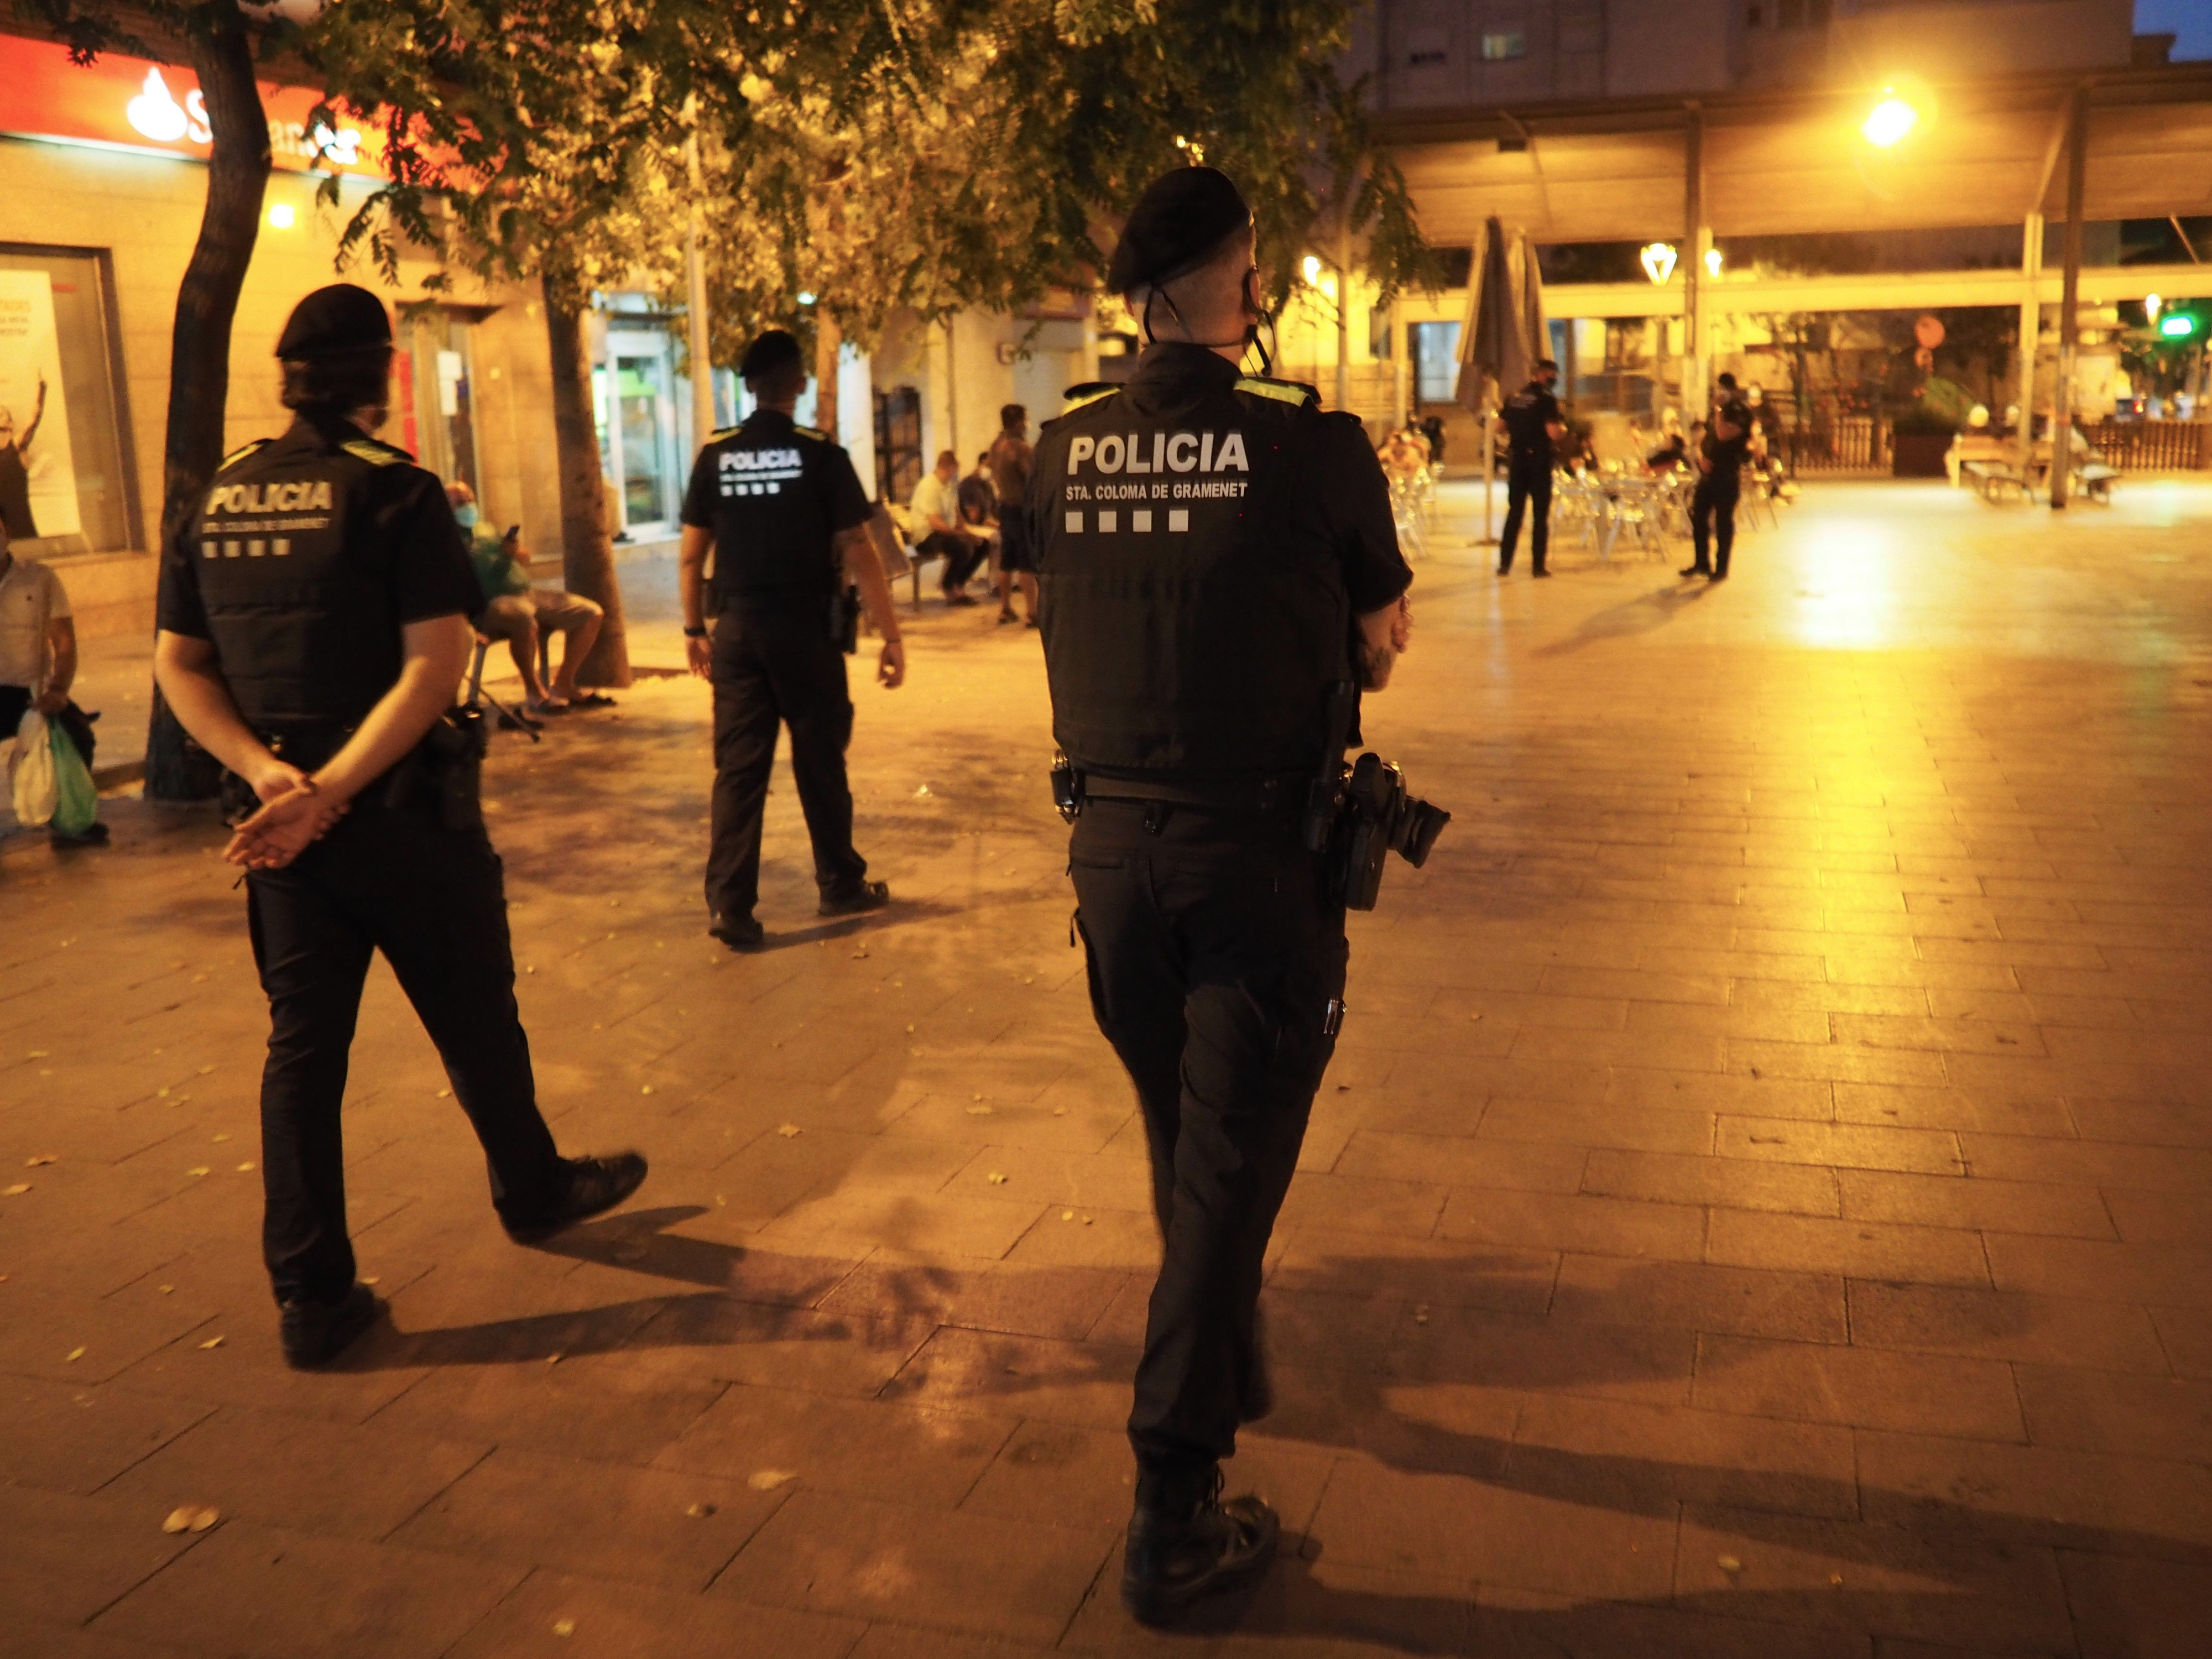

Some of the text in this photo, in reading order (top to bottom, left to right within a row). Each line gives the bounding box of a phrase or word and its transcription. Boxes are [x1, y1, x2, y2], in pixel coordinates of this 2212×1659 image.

[719, 448, 802, 471] POLICIA
[1067, 430, 1249, 476] POLICIA
[205, 481, 333, 515] POLICIA
[1066, 482, 1248, 500] STA. COLOMA DE GRAMENET
